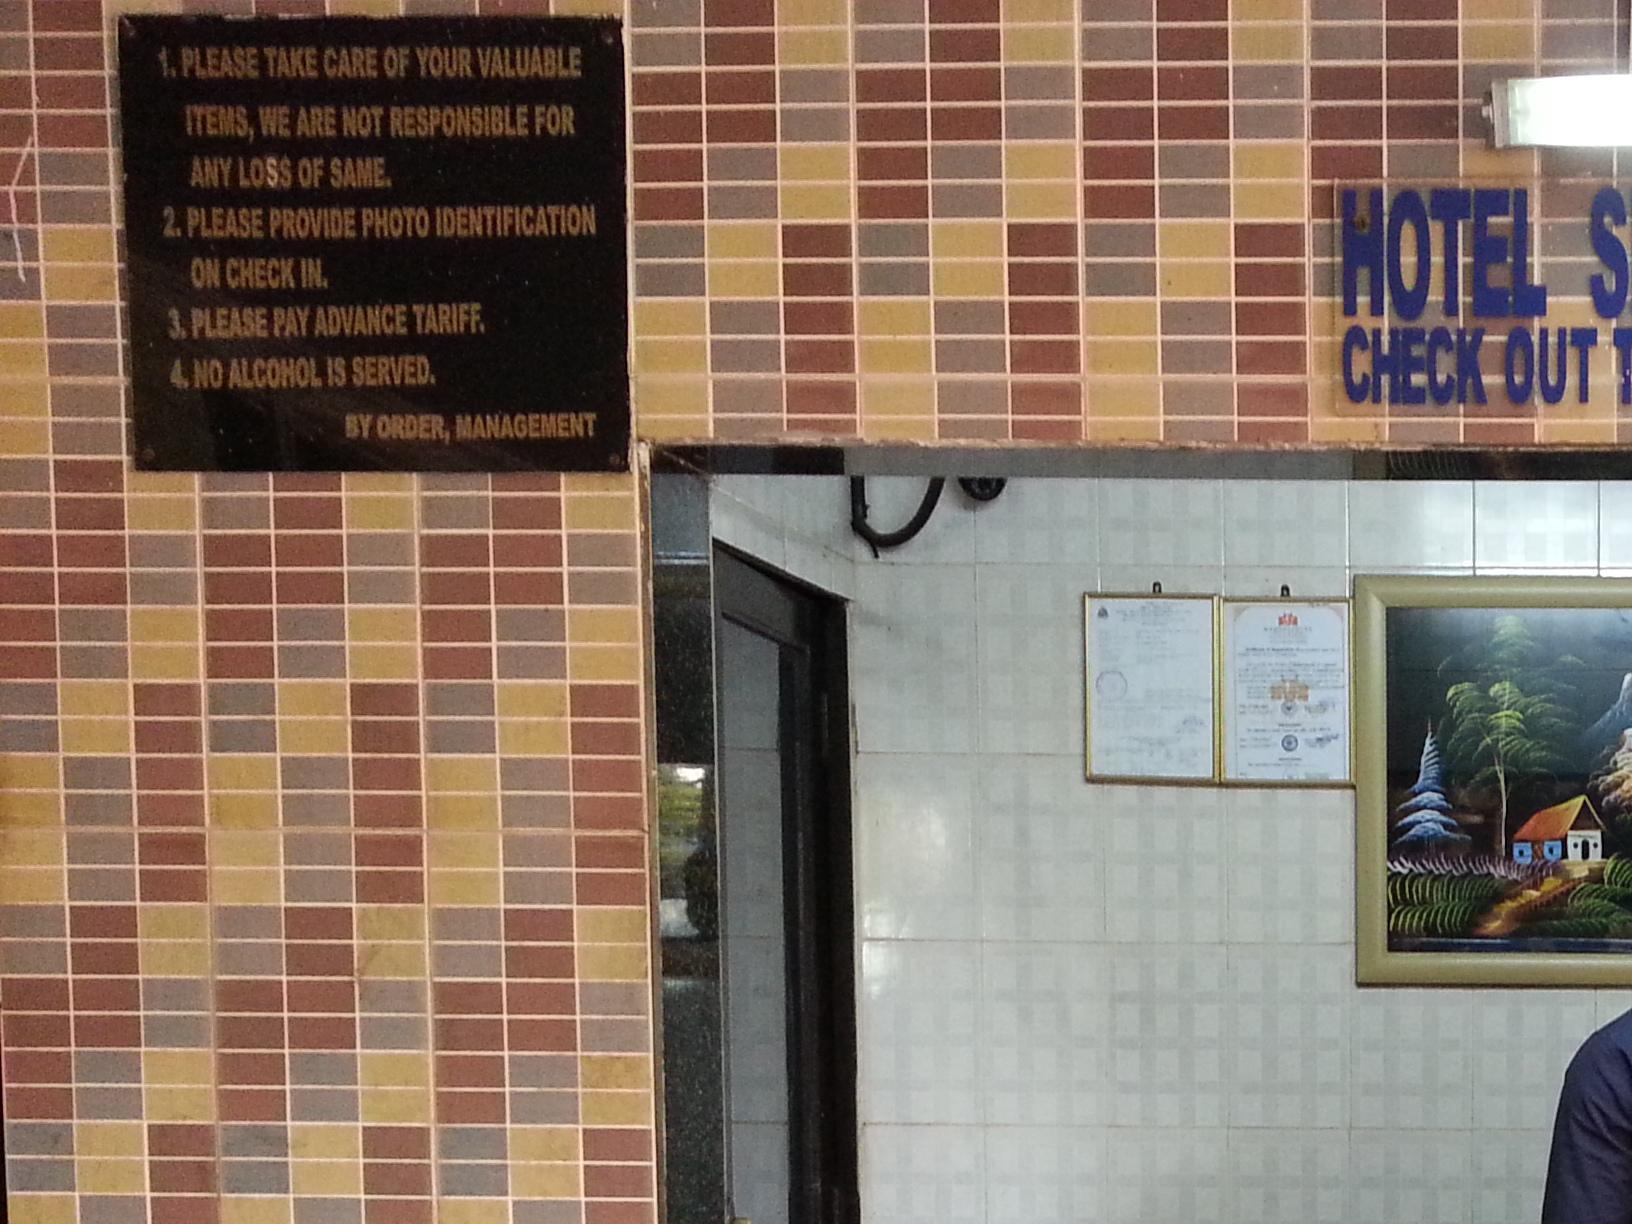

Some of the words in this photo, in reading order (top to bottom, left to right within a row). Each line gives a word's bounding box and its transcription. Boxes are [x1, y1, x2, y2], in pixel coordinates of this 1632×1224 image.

[157, 47, 177, 78] 1.
[182, 47, 259, 79] PLEASE
[264, 47, 318, 78] TAKE
[323, 47, 378, 78] CARE
[384, 46, 410, 77] OF
[416, 46, 473, 77] YOUR
[477, 46, 582, 77] VALUABLE
[185, 105, 255, 142] ITEMS,
[258, 106, 291, 137] WE
[297, 106, 337, 137] ARE
[343, 106, 384, 137] NOT
[390, 105, 529, 137] RESPONSIBLE
[534, 105, 575, 135] FOR
[190, 156, 231, 188] ANY
[240, 156, 292, 188] LOSS
[299, 156, 324, 188] OF
[330, 156, 392, 189] SAME.
[163, 206, 182, 238] 2.
[187, 207, 264, 239] PLEASE
[269, 207, 356, 239] PROVIDE
[362, 207, 430, 239] PHOTO
[436, 205, 597, 237] IDENTIFICATION
[1342, 187, 1547, 319] HOTEL
[191, 257, 220, 289] ON
[226, 258, 295, 289] CHECK
[301, 258, 329, 289] IN.
[167, 307, 187, 340] 3.
[191, 307, 269, 340] PLEASE
[273, 305, 311, 337] PAY
[314, 304, 408, 336] ADVANCE
[412, 302, 485, 335] TARIFF.
[170, 359, 189, 389] 4.
[193, 358, 224, 389] NO
[228, 358, 322, 389] ALCOHOL
[327, 357, 347, 387] IS
[351, 355, 436, 387] SERVED.
[1342, 325, 1487, 404] CHECK
[1505, 326, 1598, 404] OUT
[345, 413, 373, 439] BY
[376, 413, 450, 445] ORDER,
[455, 411, 598, 440] MANAGEMENT
